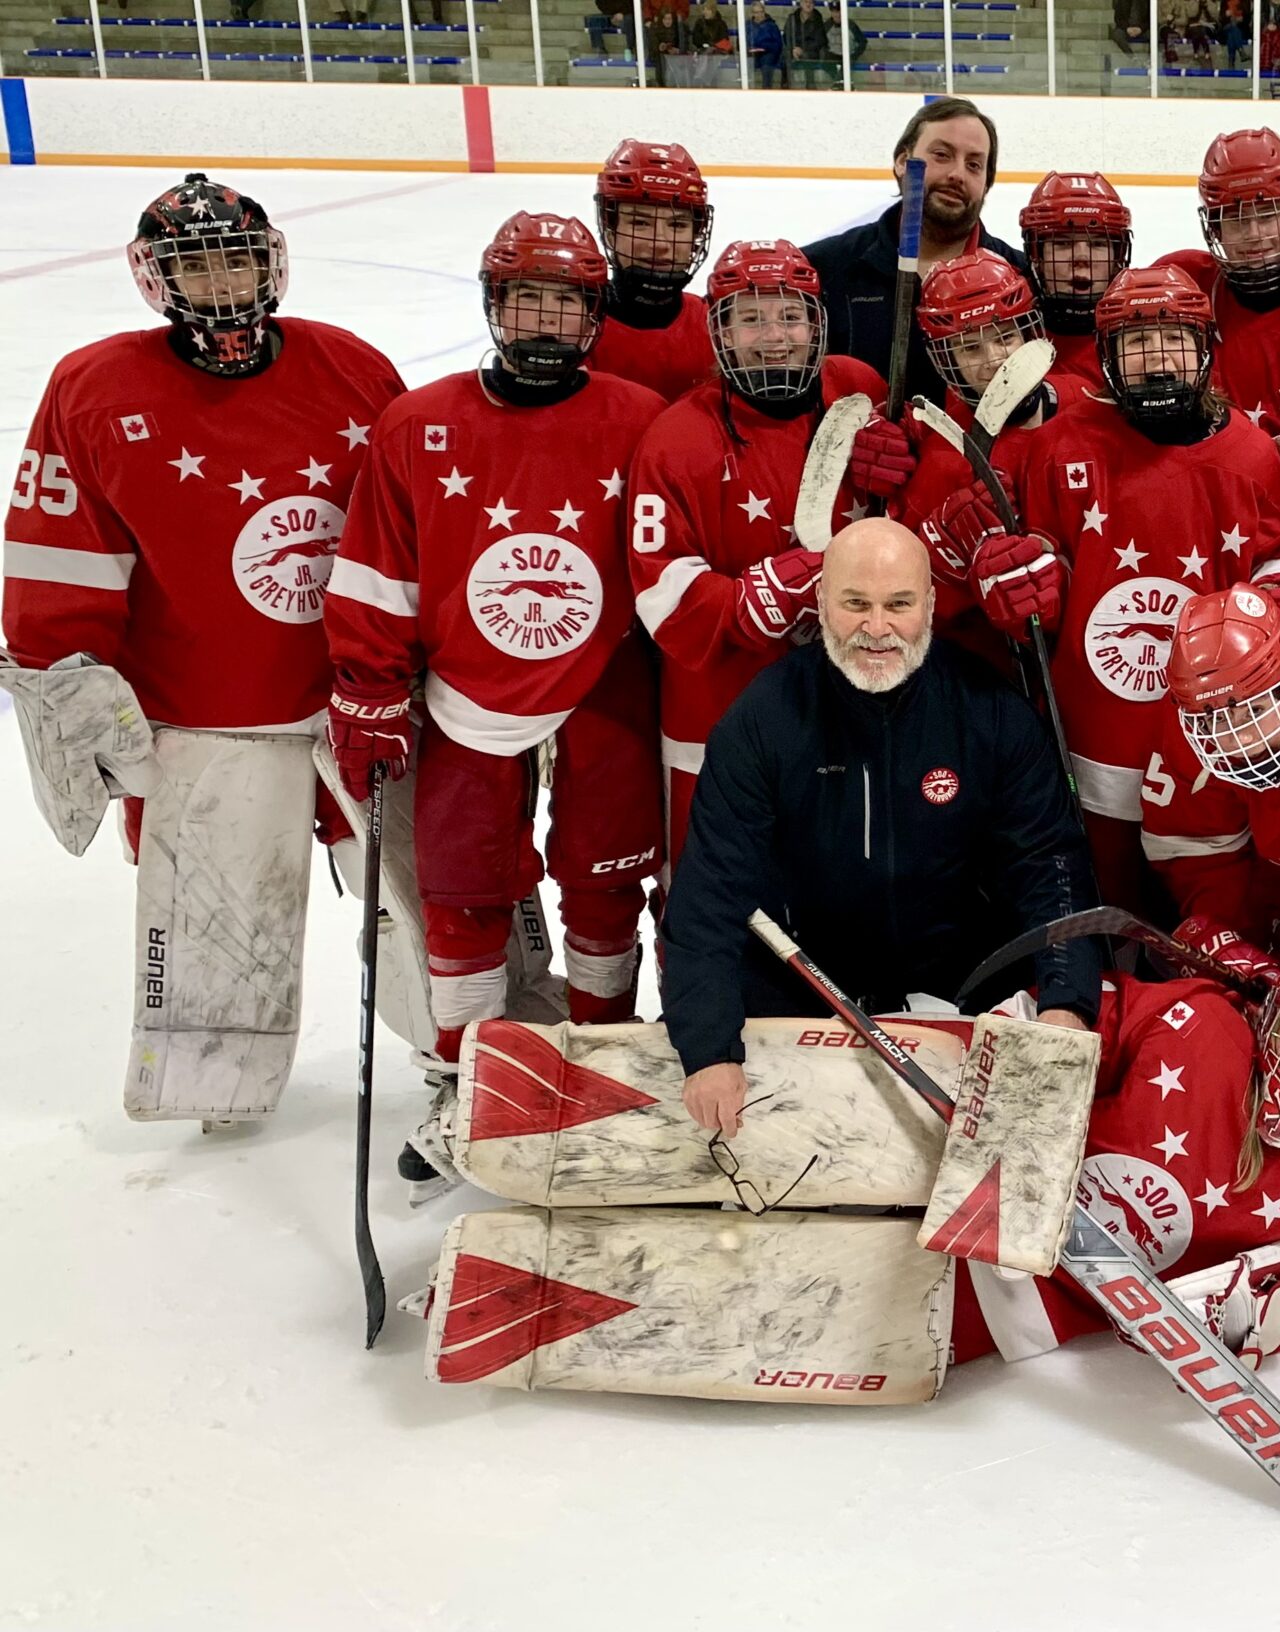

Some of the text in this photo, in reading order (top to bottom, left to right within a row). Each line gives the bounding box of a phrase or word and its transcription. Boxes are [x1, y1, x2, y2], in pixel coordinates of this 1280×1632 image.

[642, 174, 681, 186] CCM
[1063, 206, 1100, 214] BAUER
[184, 219, 233, 231] BAUER
[538, 221, 565, 239] 17
[749, 263, 784, 272] CCM
[960, 303, 996, 320] CCM
[1130, 296, 1169, 306] BAUER
[213, 330, 249, 363] 35
[11, 448, 78, 516] 35
[270, 508, 318, 537] SOO
[632, 493, 667, 553] 8
[511, 545, 561, 573] SOO
[294, 564, 318, 587] JR.
[249, 572, 332, 614] GREYHOU
[1132, 590, 1179, 617] SOO
[478, 602, 591, 650] GREYHOUNDS
[523, 602, 547, 624] JR.
[1095, 645, 1170, 693] GREYHOU
[1138, 644, 1160, 667] JR.
[329, 691, 411, 721] BAUER
[1195, 684, 1235, 701] BAUER
[933, 770, 948, 780] SOO
[591, 846, 656, 875] CCM
[519, 900, 545, 953] UER
[146, 926, 166, 1009] BAUER
[804, 962, 848, 1002] SUPREME
[869, 1029, 909, 1064] MACH
[961, 1030, 999, 1141] BAUER
[1134, 1175, 1178, 1220] SOO
[754, 1367, 889, 1393] BAUER
